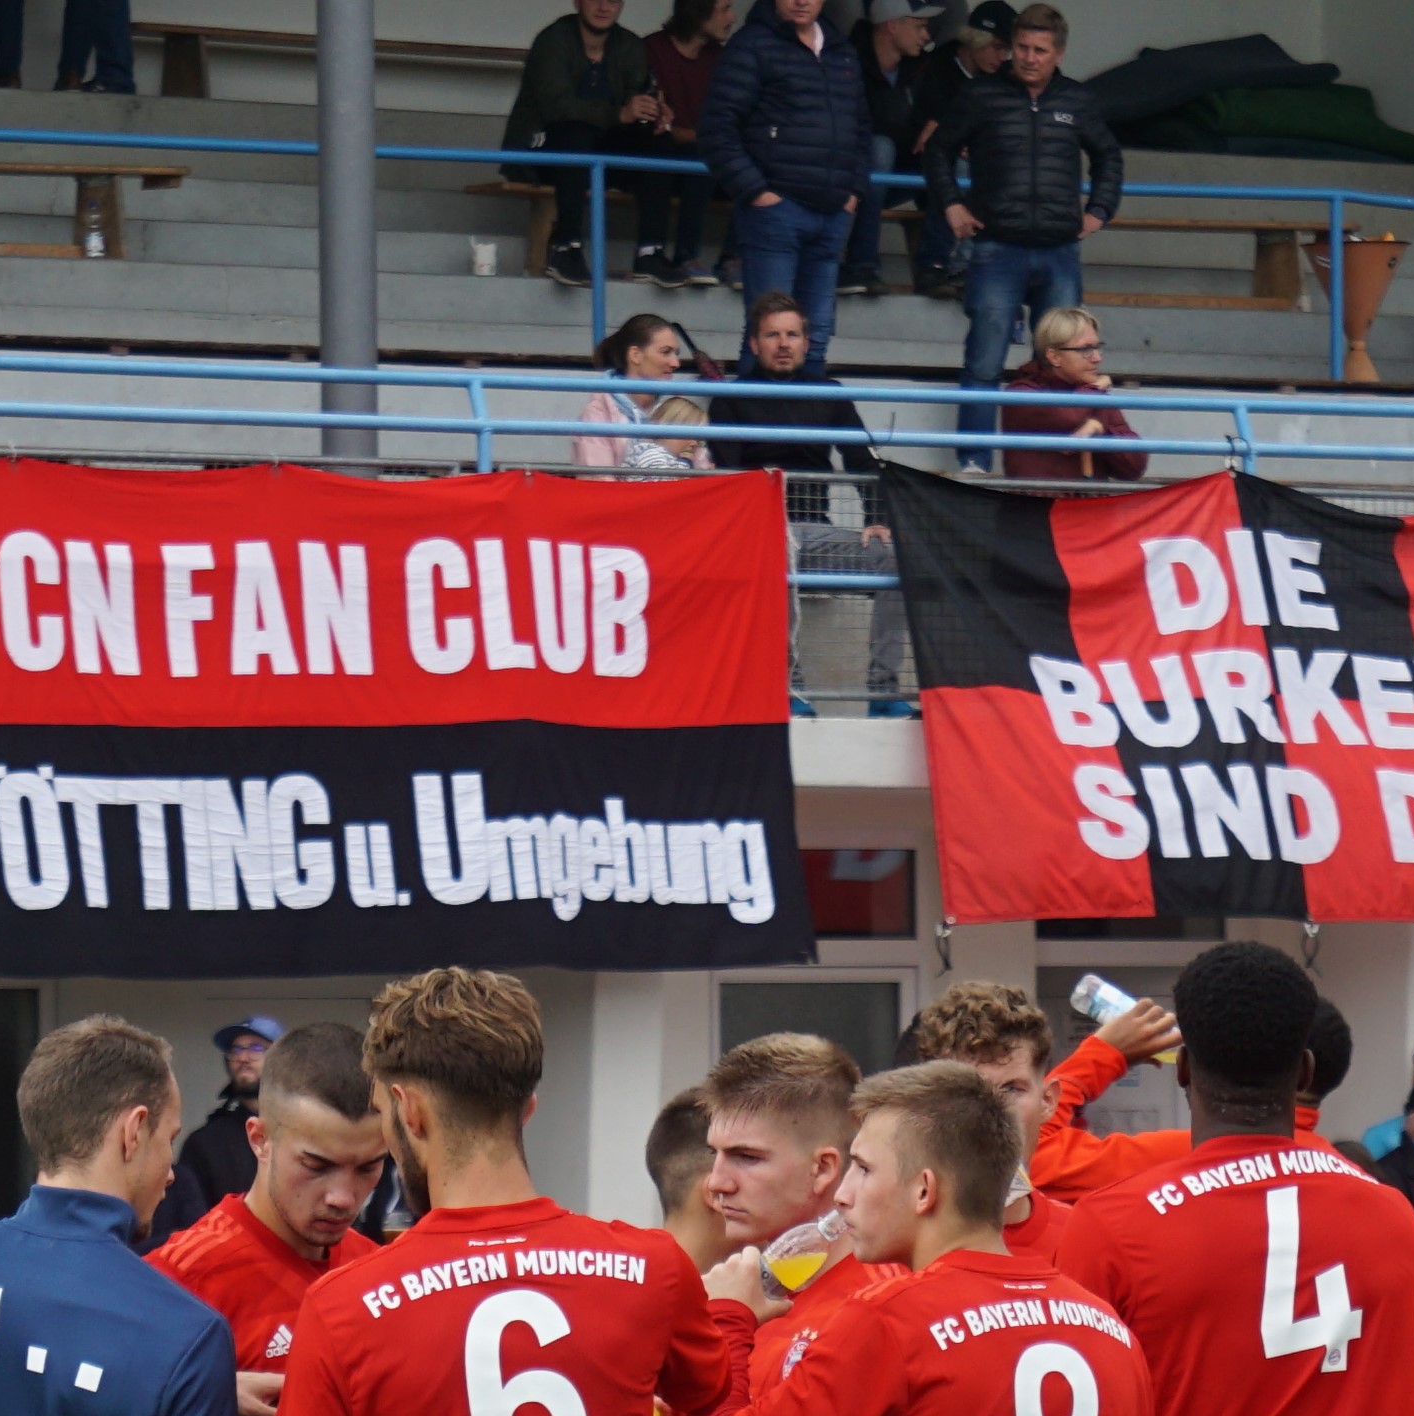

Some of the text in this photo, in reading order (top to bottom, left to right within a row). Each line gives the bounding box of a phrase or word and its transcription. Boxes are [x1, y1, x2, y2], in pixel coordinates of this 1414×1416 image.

[161, 541, 375, 678] FAN
[405, 537, 652, 679] CLUB
[1139, 527, 1340, 636] DIE
[344, 822, 411, 909] u.
[412, 772, 776, 925] Umgebung
[1072, 763, 1341, 866] SIND
[1147, 1184, 1184, 1215] FC
[1181, 1153, 1276, 1197] BAYERN
[362, 1249, 647, 1319] FC BAYERN MÜNCHEN
[929, 1317, 965, 1351] FC
[962, 1299, 1047, 1337] BAYERN
[1260, 1185, 1364, 1374] 4
